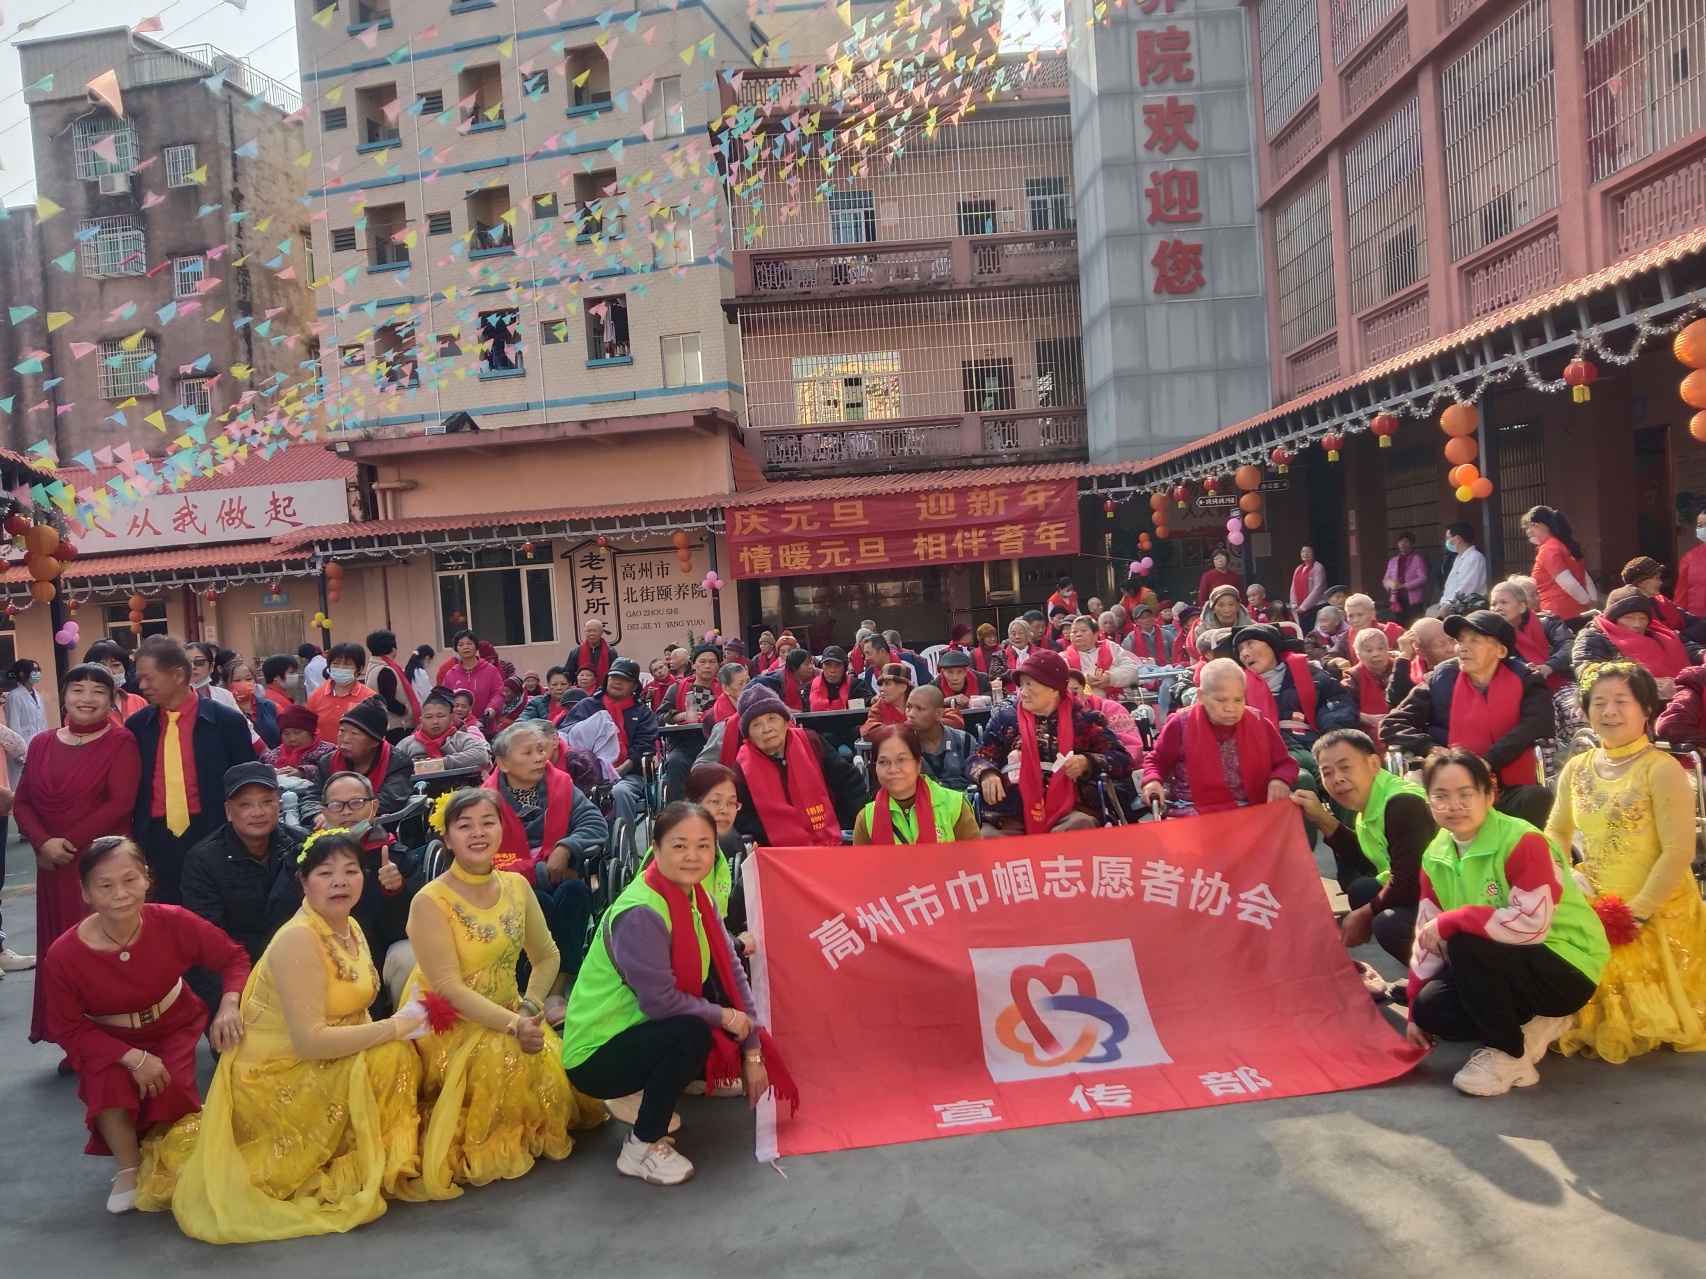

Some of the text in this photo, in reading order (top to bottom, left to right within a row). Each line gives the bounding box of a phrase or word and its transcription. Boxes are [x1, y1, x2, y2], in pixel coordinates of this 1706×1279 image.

[1136, 0, 1206, 294] 院欢迎您
[734, 483, 1060, 536] 庆元旦 迎新年
[620, 560, 670, 582] 高州市
[739, 536, 890, 575] 情暖元旦
[912, 521, 1071, 562] 相伴耆年
[579, 551, 613, 636] 老有所
[622, 581, 709, 603] 北街颐养院
[625, 607, 679, 618] GAO ZHOU SHI
[627, 618, 706, 631] BEI JIE YI YANG YUAN
[808, 854, 1283, 970] 高州市巾帼志愿者协会
[933, 1065, 1274, 1128] 宣传部
